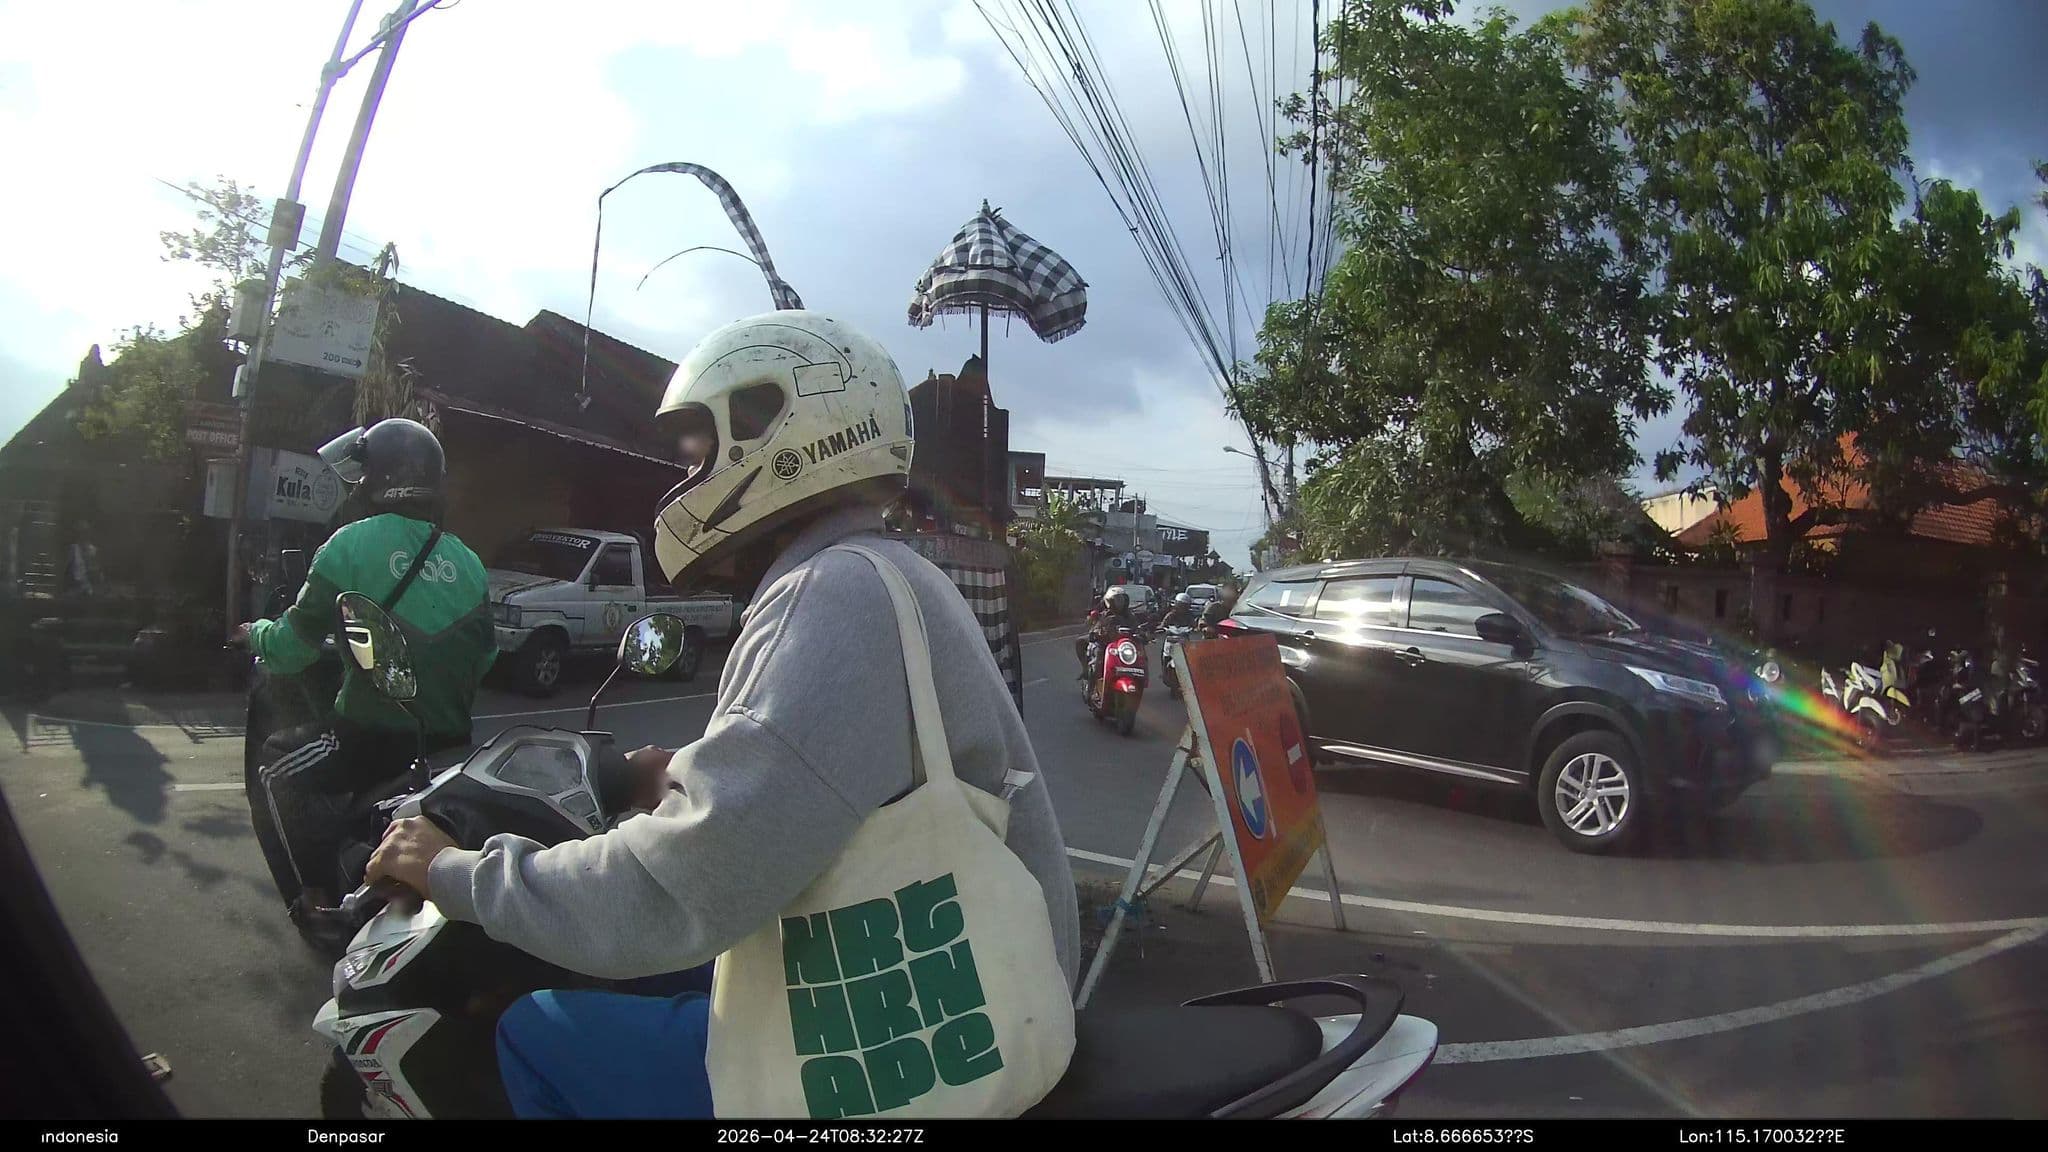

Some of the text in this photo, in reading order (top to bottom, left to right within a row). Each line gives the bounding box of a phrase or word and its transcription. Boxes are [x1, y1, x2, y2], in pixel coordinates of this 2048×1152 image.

[209, 432, 240, 446] OFFICE
[802, 417, 882, 464] YAMAHA
[276, 476, 311, 500] Kula
[389, 551, 457, 583] Gab
